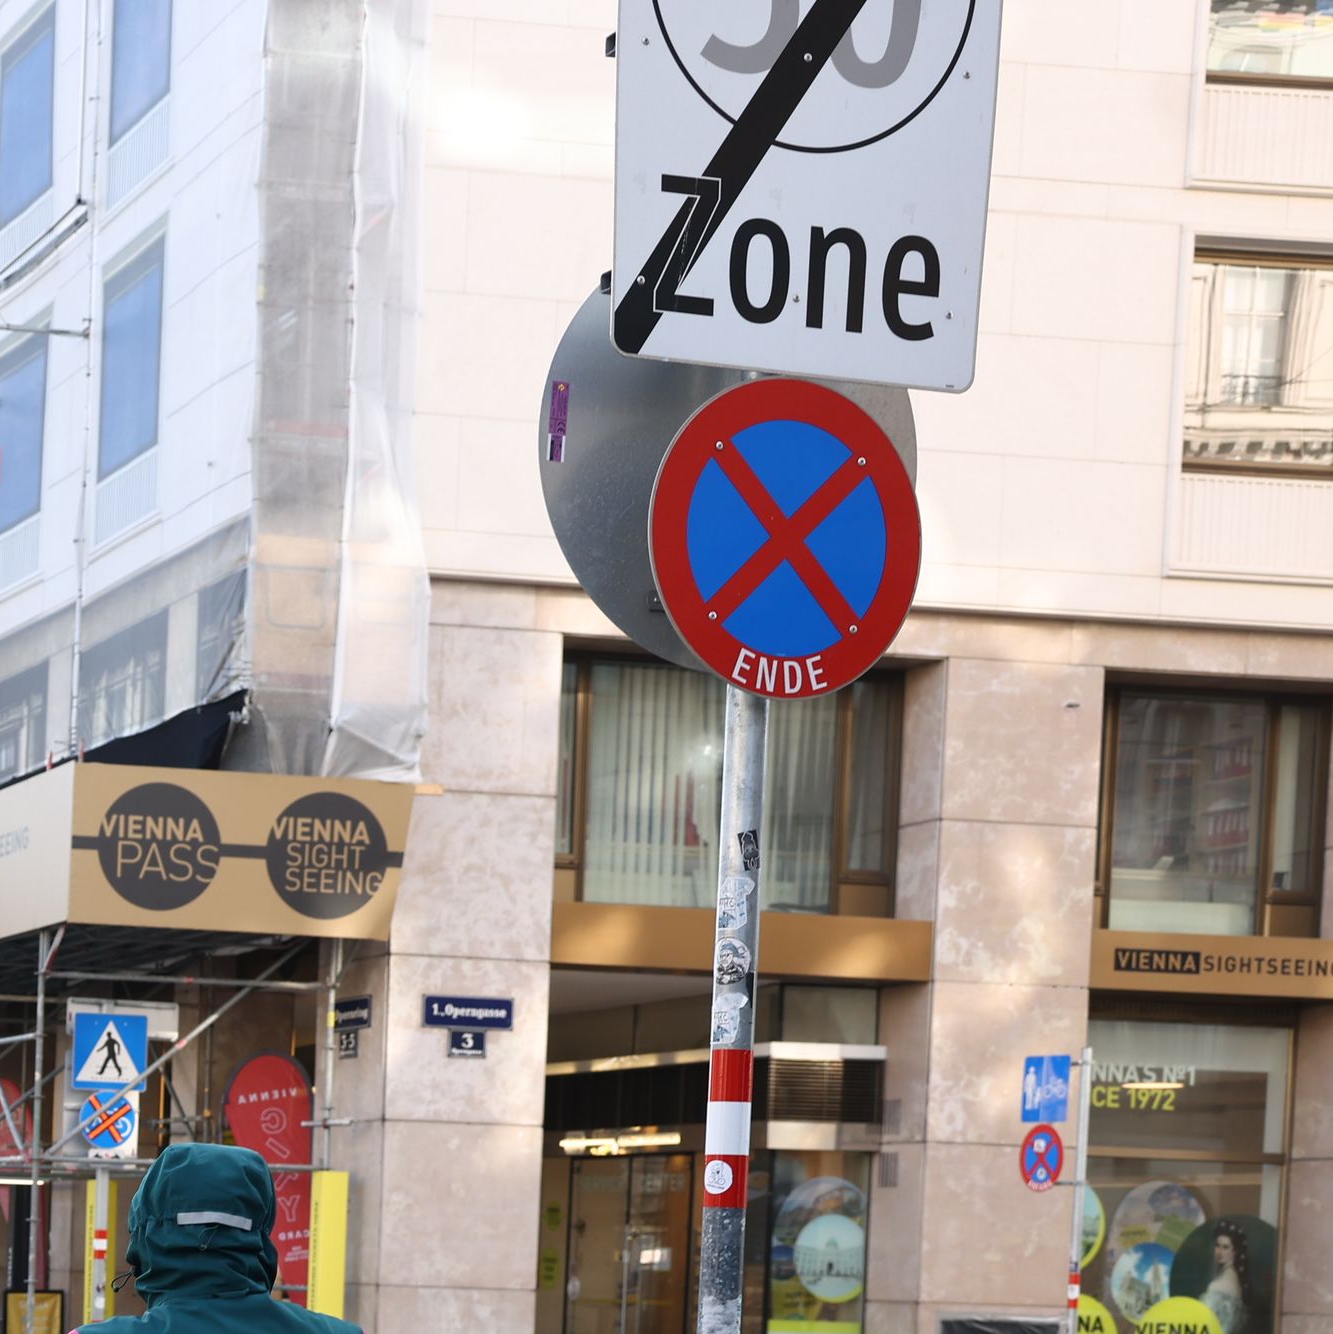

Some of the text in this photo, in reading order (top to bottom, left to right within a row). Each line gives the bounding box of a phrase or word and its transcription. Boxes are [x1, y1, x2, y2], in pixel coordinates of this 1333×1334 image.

[653, 174, 941, 341] Zone
[732, 648, 827, 694] ENDE
[101, 814, 204, 843] VIENNA
[271, 816, 370, 845] VIENNA
[116, 840, 220, 883] PASS
[286, 842, 366, 869] SIGHT
[285, 867, 382, 897] SEEING
[1117, 951, 1333, 977] VIENNA SIGHTSEEIN
[445, 1005, 507, 1020] Operngasse
[461, 1033, 474, 1048] 3
[1091, 1086, 1176, 1111] CE 1972
[1077, 1315, 1105, 1333] NA
